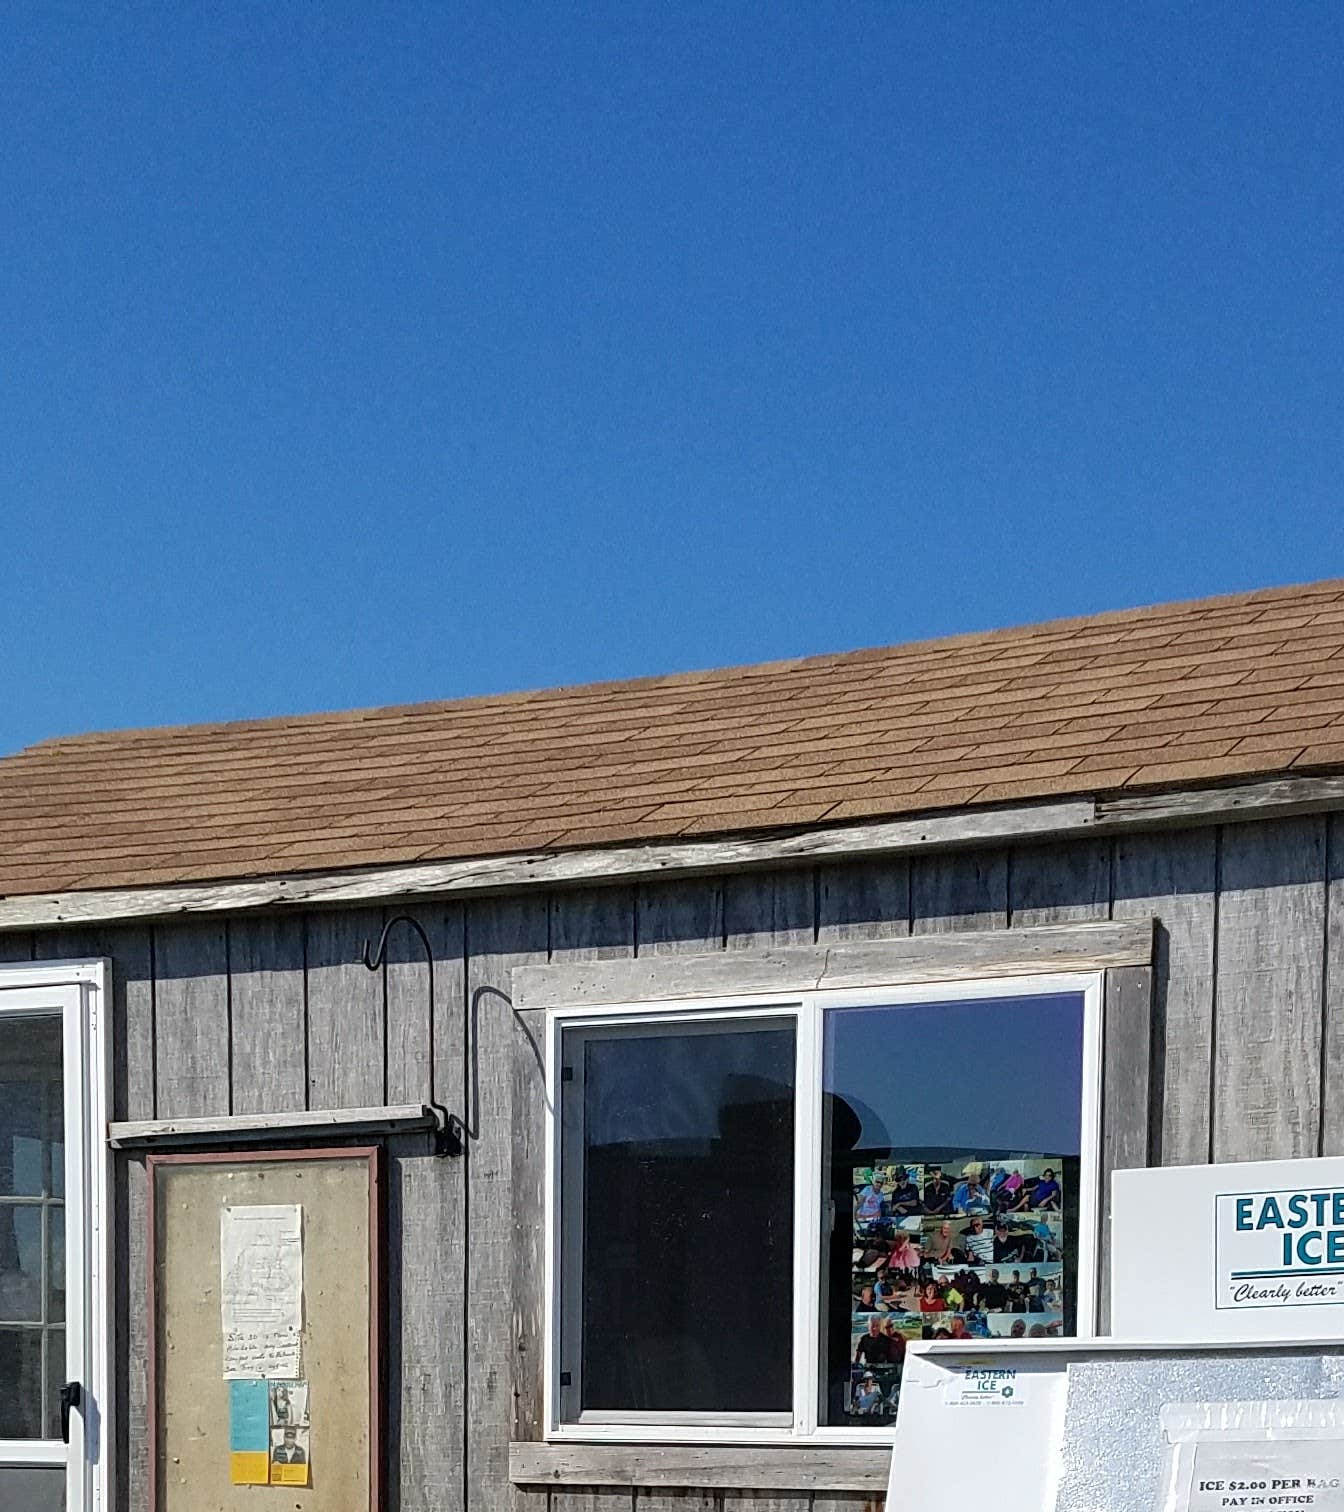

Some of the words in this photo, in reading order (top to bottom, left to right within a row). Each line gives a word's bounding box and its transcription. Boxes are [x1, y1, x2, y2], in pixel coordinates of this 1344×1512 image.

[964, 1369, 1017, 1380] EASTERN
[976, 1380, 997, 1391] ICE
[1199, 1480, 1225, 1491] ICE
[1229, 1481, 1267, 1491] $2.00
[1271, 1479, 1301, 1490] PER
[1222, 1497, 1249, 1506] PAY
[1251, 1496, 1266, 1505] IN
[1268, 1495, 1314, 1504] OFFICE
